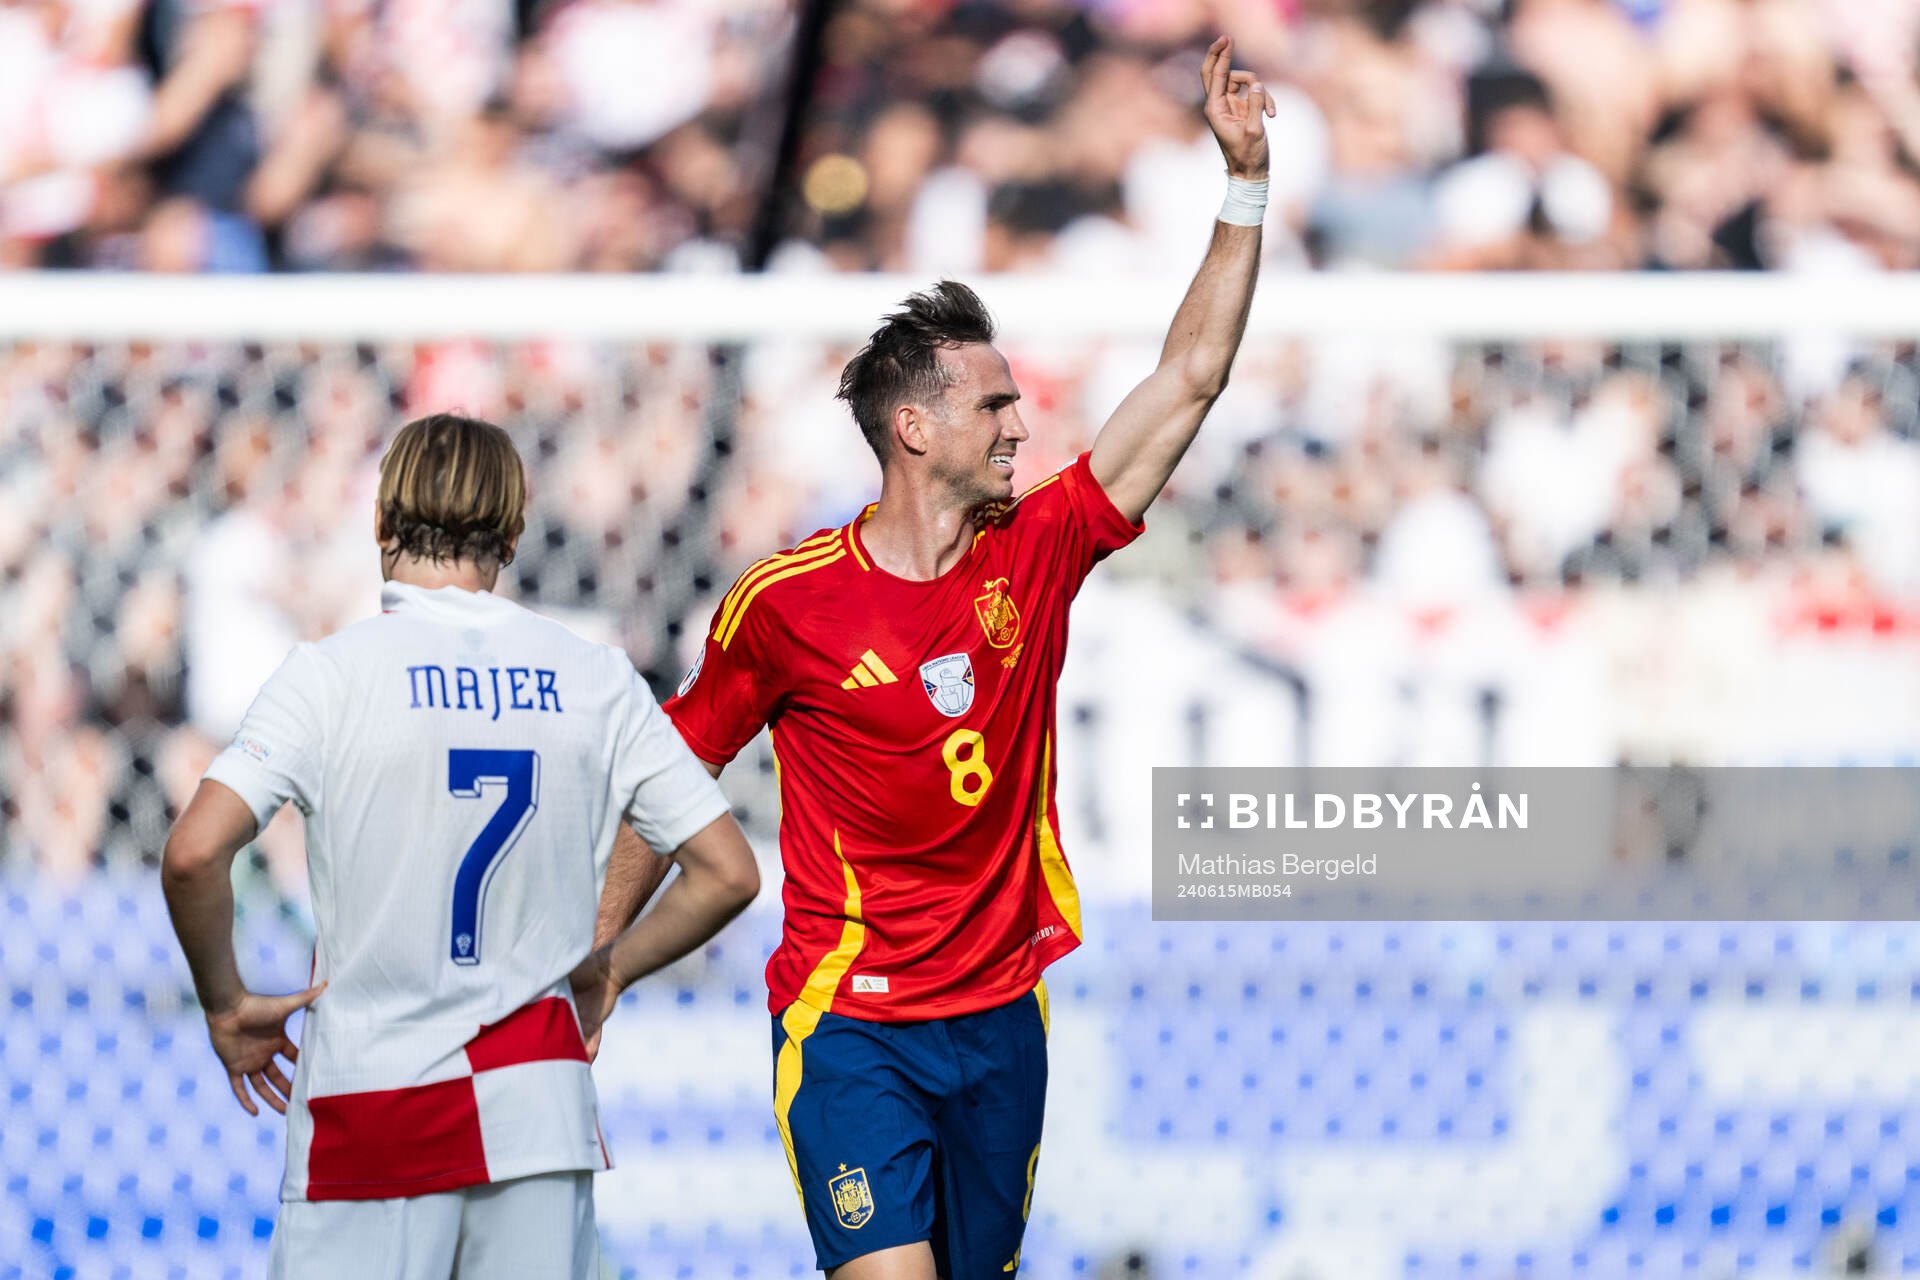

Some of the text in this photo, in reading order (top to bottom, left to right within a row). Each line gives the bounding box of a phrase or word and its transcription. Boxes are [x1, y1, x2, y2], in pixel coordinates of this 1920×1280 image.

[406, 665, 563, 721] MAJER
[942, 728, 994, 807] 8
[449, 748, 541, 966] 7
